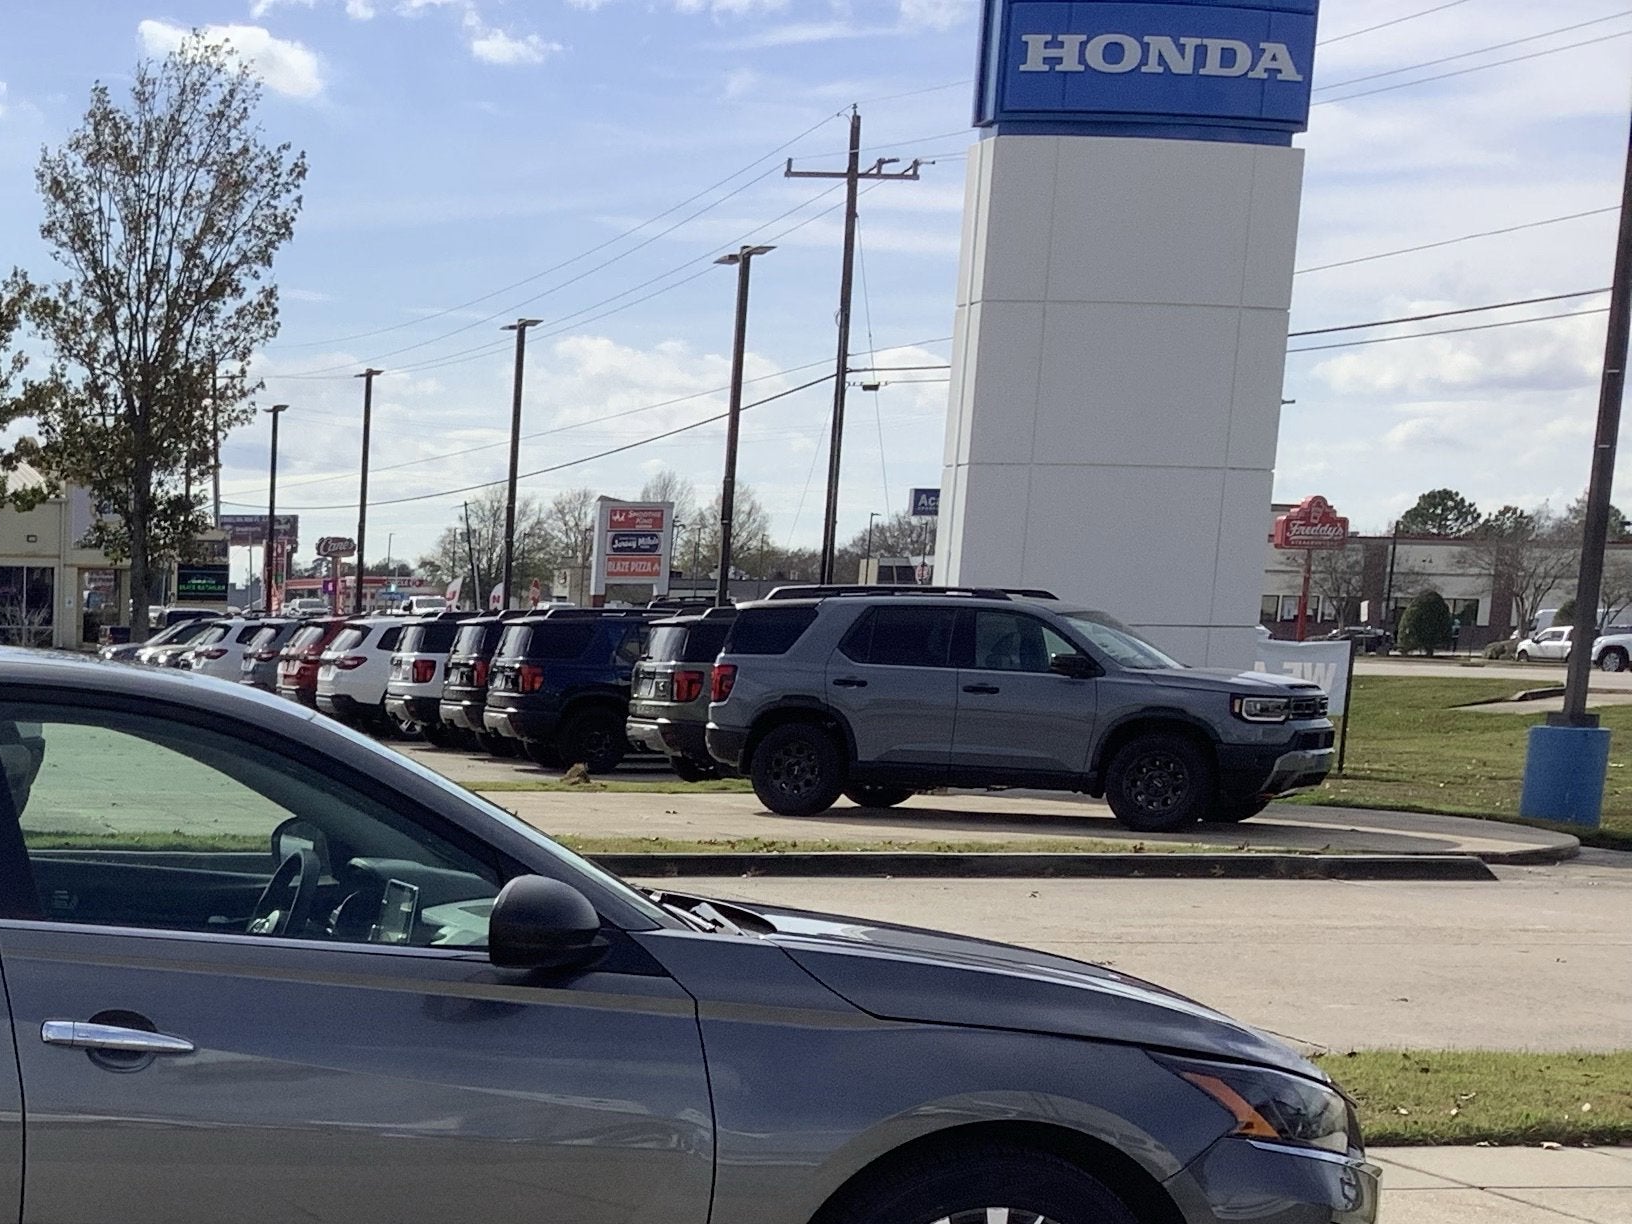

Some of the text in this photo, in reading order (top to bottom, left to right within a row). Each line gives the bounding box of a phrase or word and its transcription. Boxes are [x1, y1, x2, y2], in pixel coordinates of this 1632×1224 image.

[1019, 33, 1304, 82] HONDA
[1287, 520, 1345, 538] Freddy's
[630, 561, 652, 573] PIZZA
